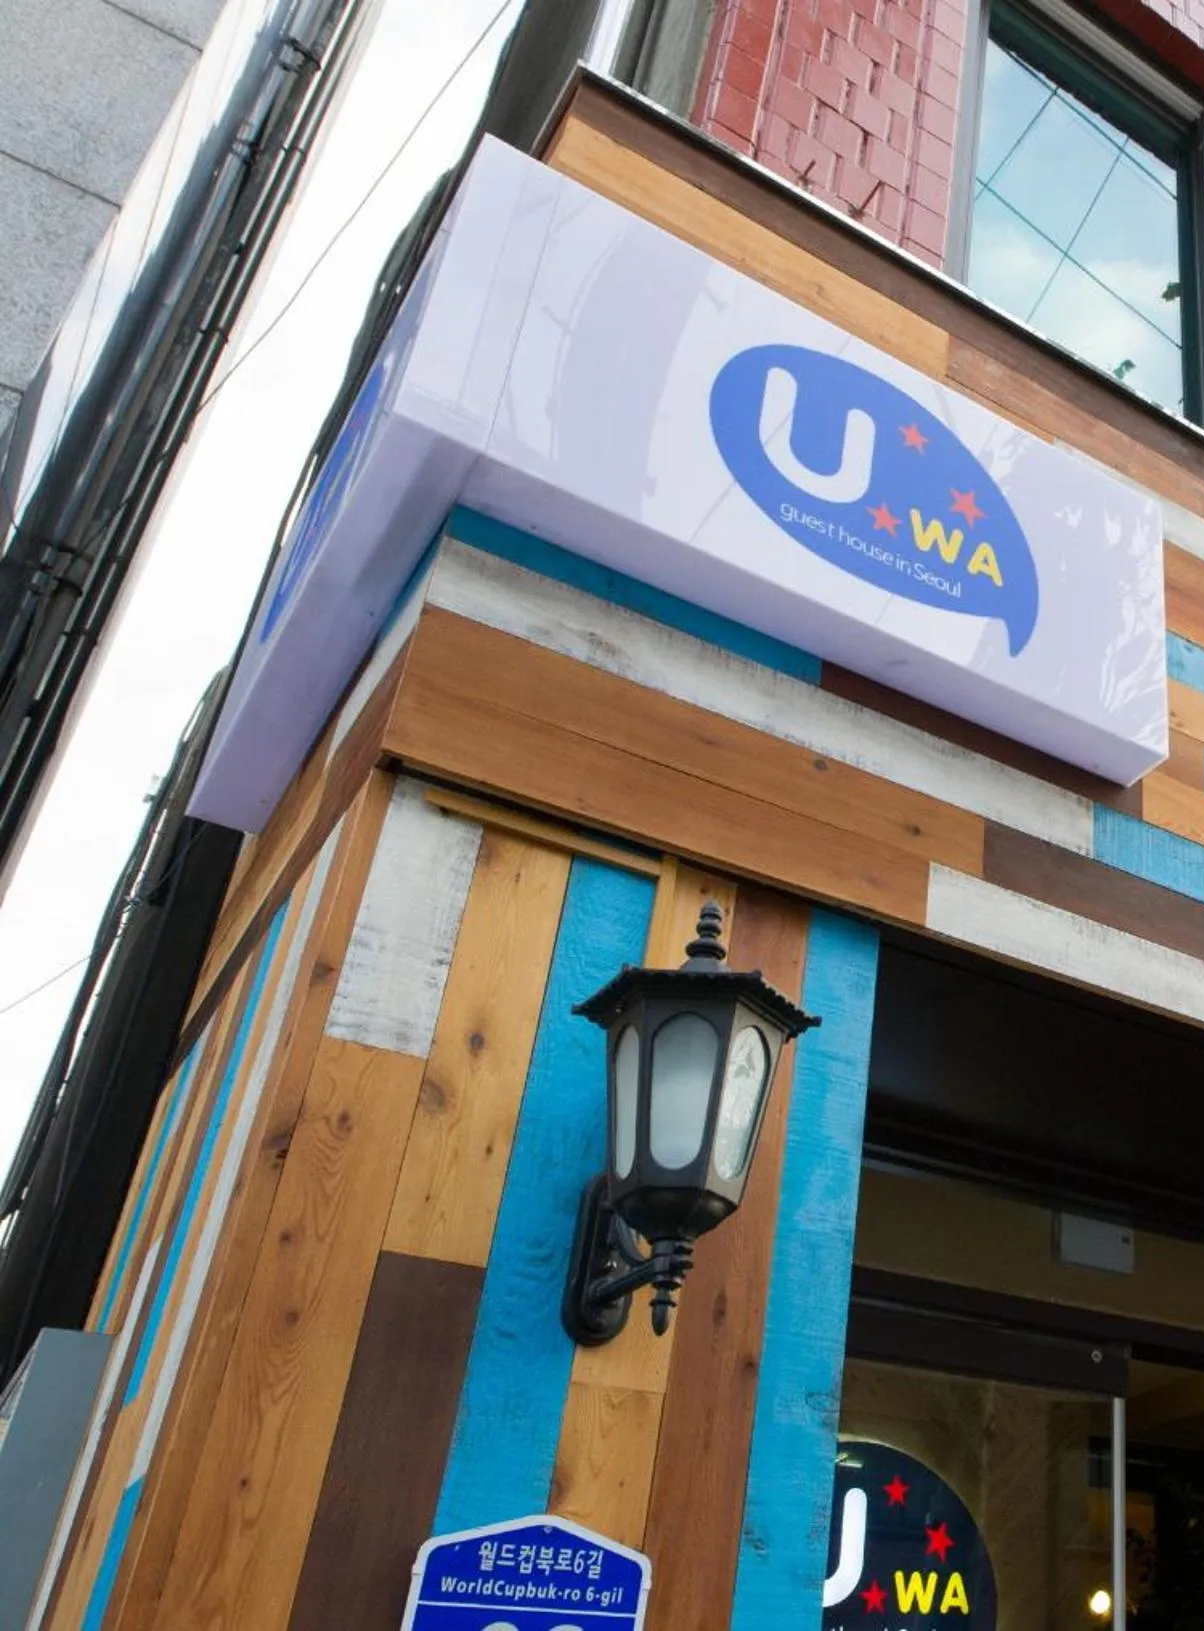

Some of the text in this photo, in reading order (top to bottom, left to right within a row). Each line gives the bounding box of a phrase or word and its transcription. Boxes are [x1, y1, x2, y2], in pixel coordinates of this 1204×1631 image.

[759, 366, 1003, 587] U WA
[779, 503, 962, 599] guest house in Seoul
[478, 1541, 604, 1580] 월드컵북로6길
[440, 1576, 624, 1607] WorldCupbuk-ro 6-gil
[894, 1570, 969, 1615] WA
